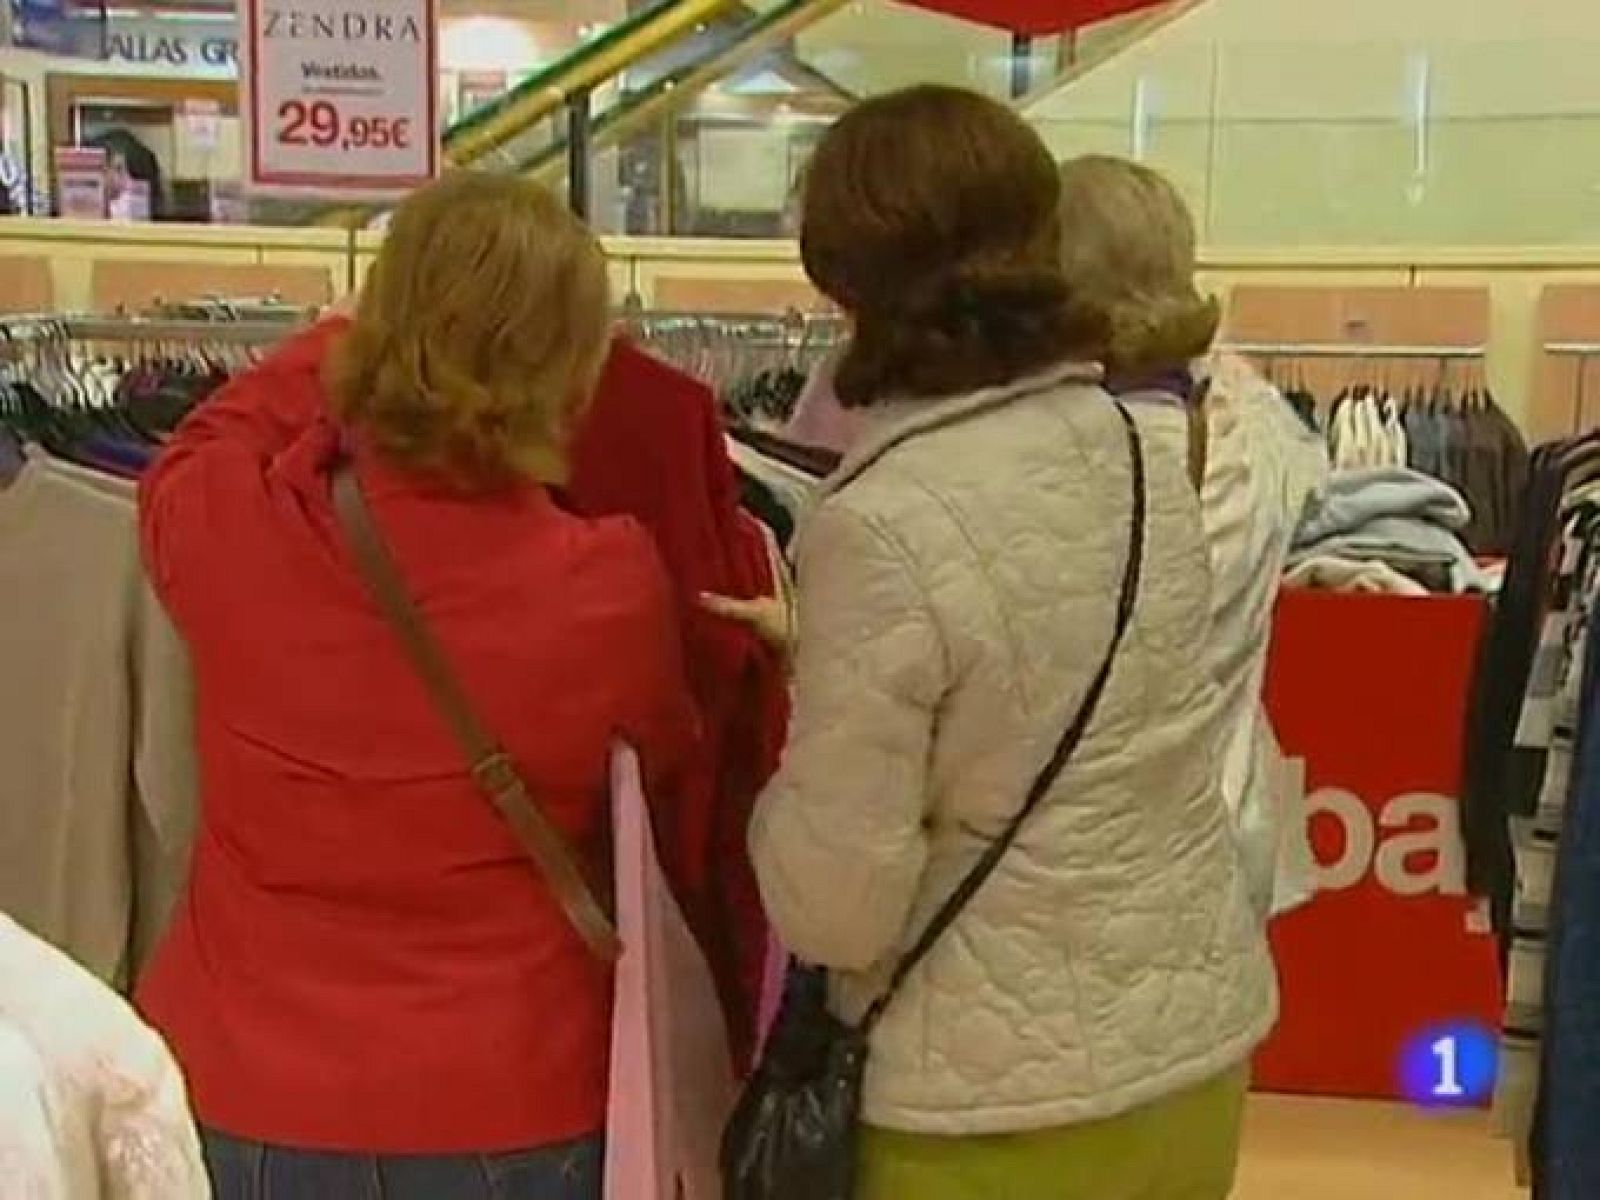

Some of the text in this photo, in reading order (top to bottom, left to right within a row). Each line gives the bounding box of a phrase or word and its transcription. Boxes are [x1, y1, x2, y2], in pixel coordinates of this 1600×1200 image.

[263, 9, 420, 41] ZENDRA
[278, 100, 411, 151] 29,95€
[1279, 757, 1490, 933] ba
